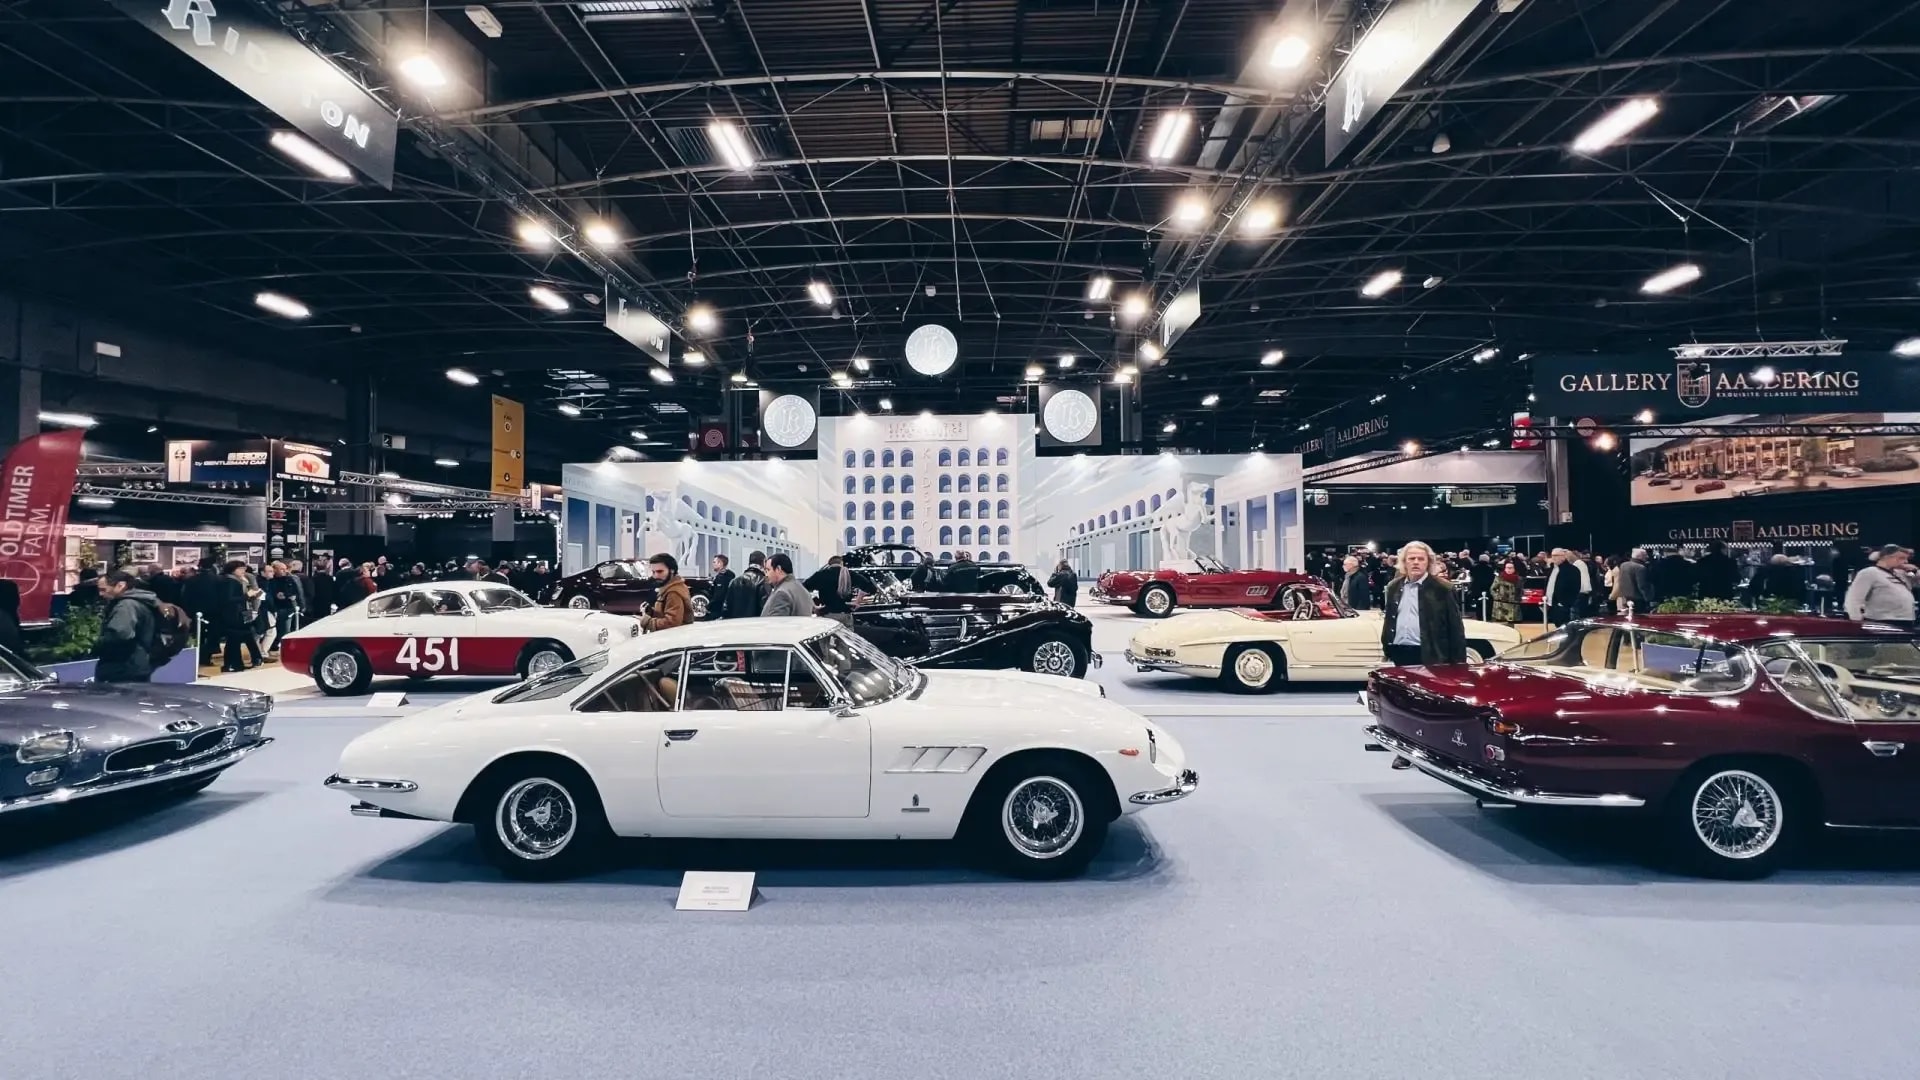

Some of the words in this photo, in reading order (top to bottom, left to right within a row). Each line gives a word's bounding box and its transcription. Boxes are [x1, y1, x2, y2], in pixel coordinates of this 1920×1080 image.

[1559, 373, 1673, 392] GALLERY
[1337, 415, 1389, 444] AALDERING
[0, 465, 35, 556] OLDTIMER
[1669, 527, 1730, 540] GALLERY
[1757, 522, 1859, 539] AALDERING
[395, 637, 460, 672] 451
